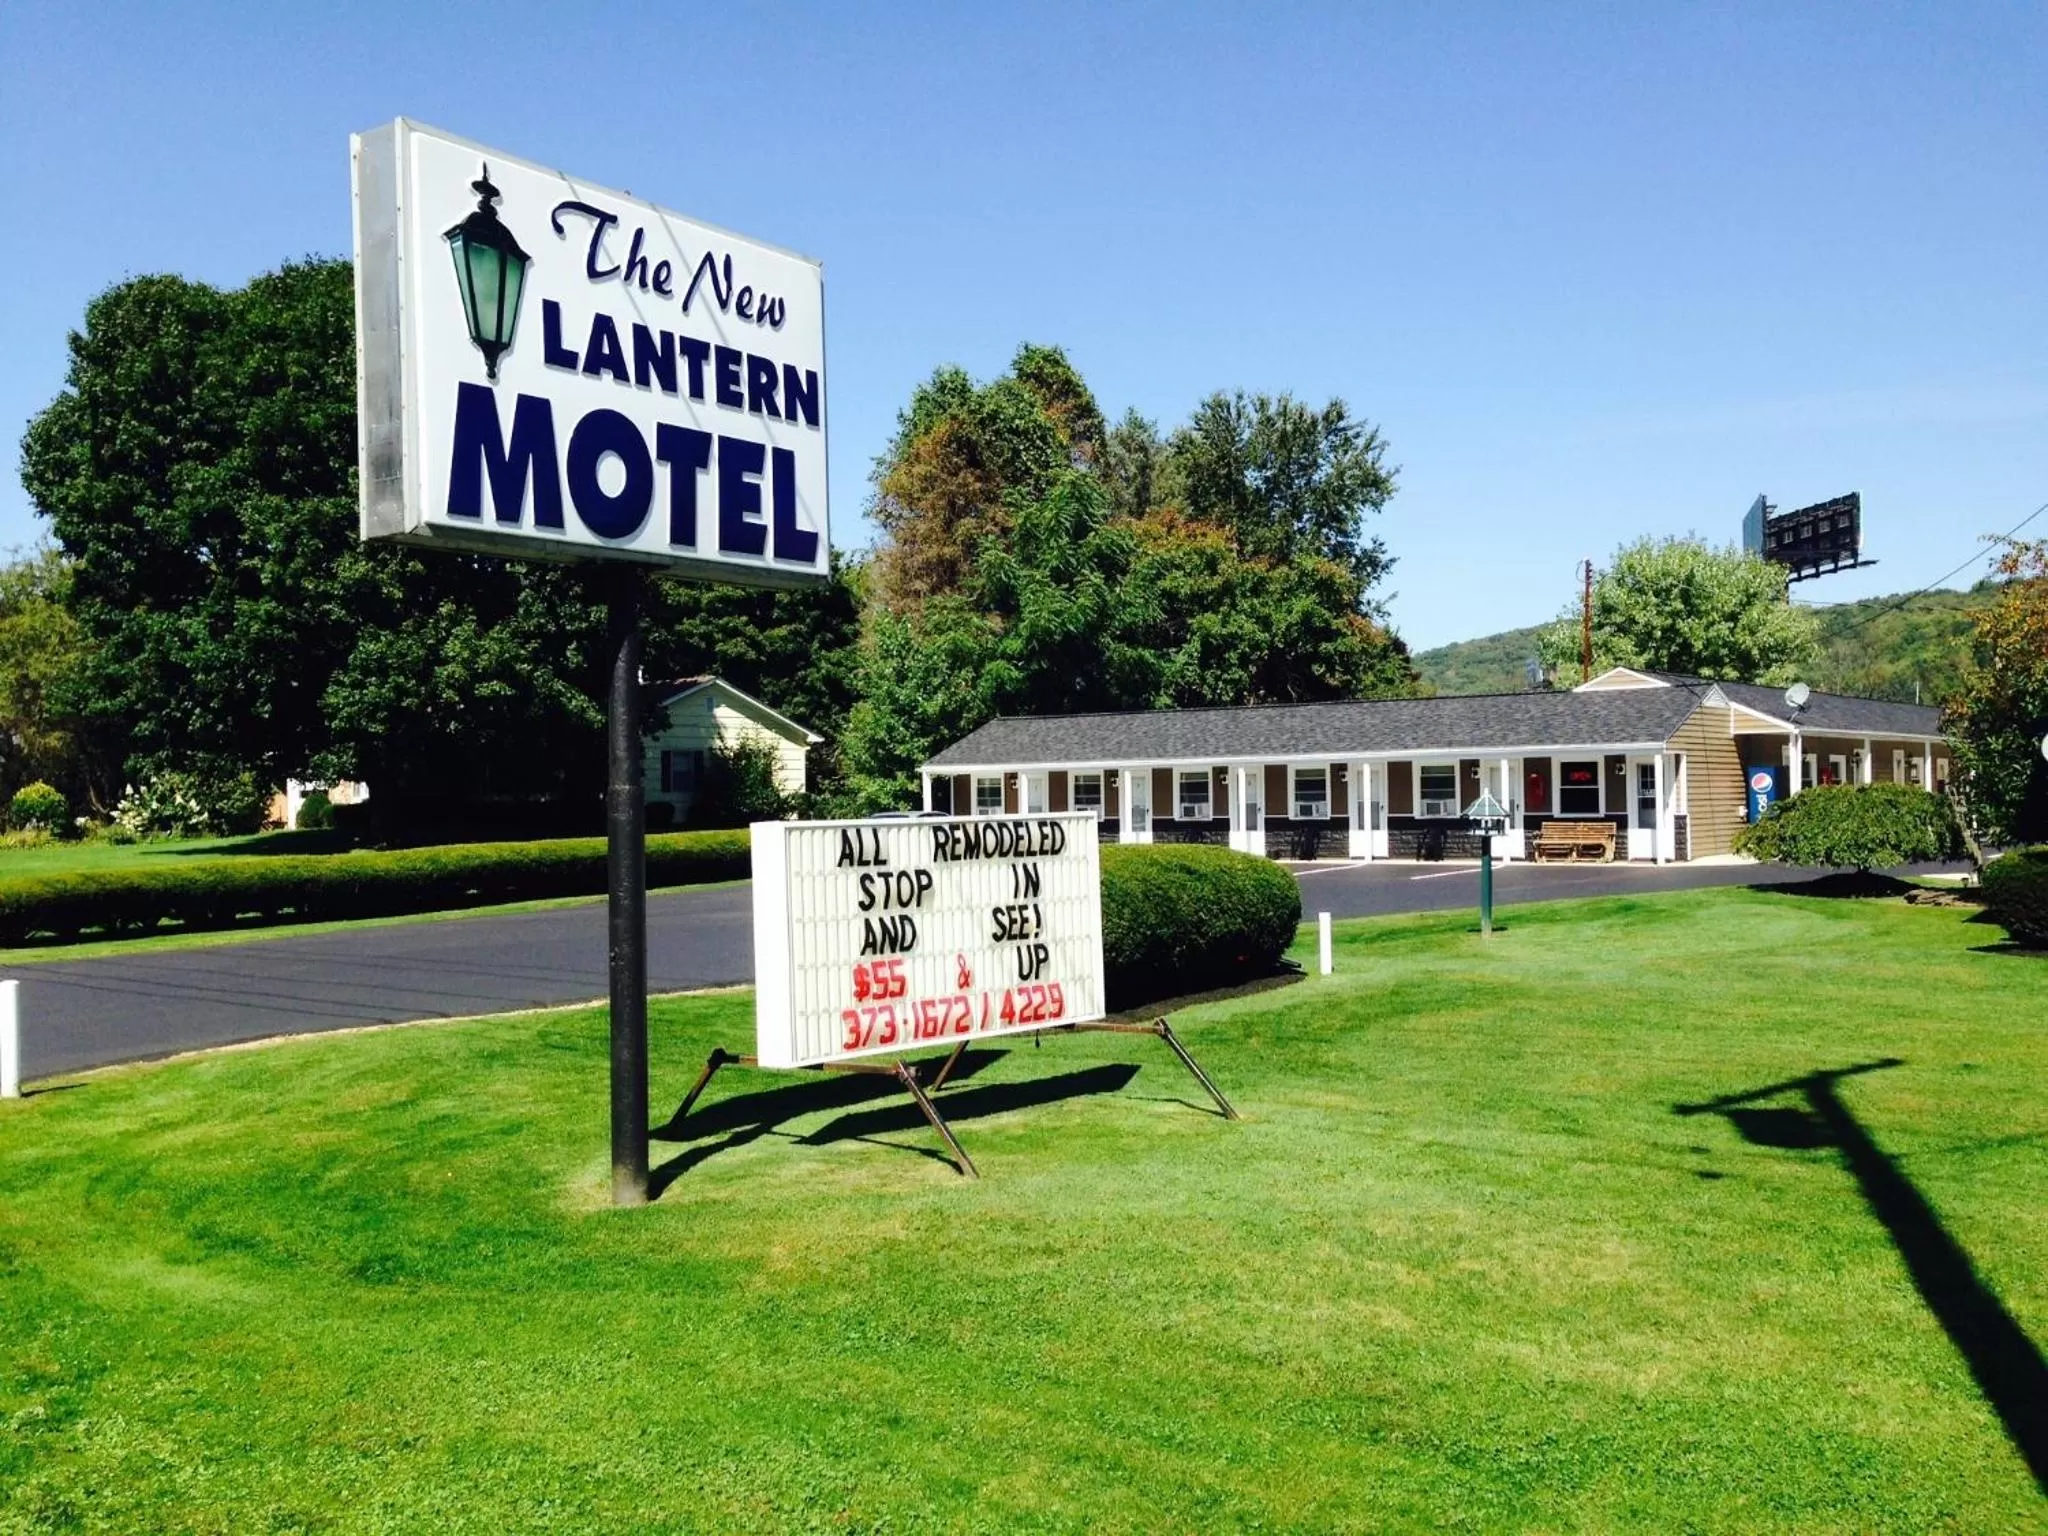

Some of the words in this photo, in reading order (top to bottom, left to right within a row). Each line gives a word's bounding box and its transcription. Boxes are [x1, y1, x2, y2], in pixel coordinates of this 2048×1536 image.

[551, 201, 673, 295] The
[682, 251, 786, 329] New
[542, 298, 820, 427] LANTERN
[447, 381, 818, 563] MOTEL
[837, 827, 888, 868] ALL
[933, 821, 1066, 862] REMODELED
[859, 868, 934, 911] STOP
[1011, 863, 1041, 899] IN
[860, 914, 917, 956] AND
[991, 903, 1043, 943] SEE!
[852, 958, 906, 1002] $55
[957, 953, 971, 990] &
[1016, 943, 1050, 981] UP
[1000, 982, 1066, 1026] 4229
